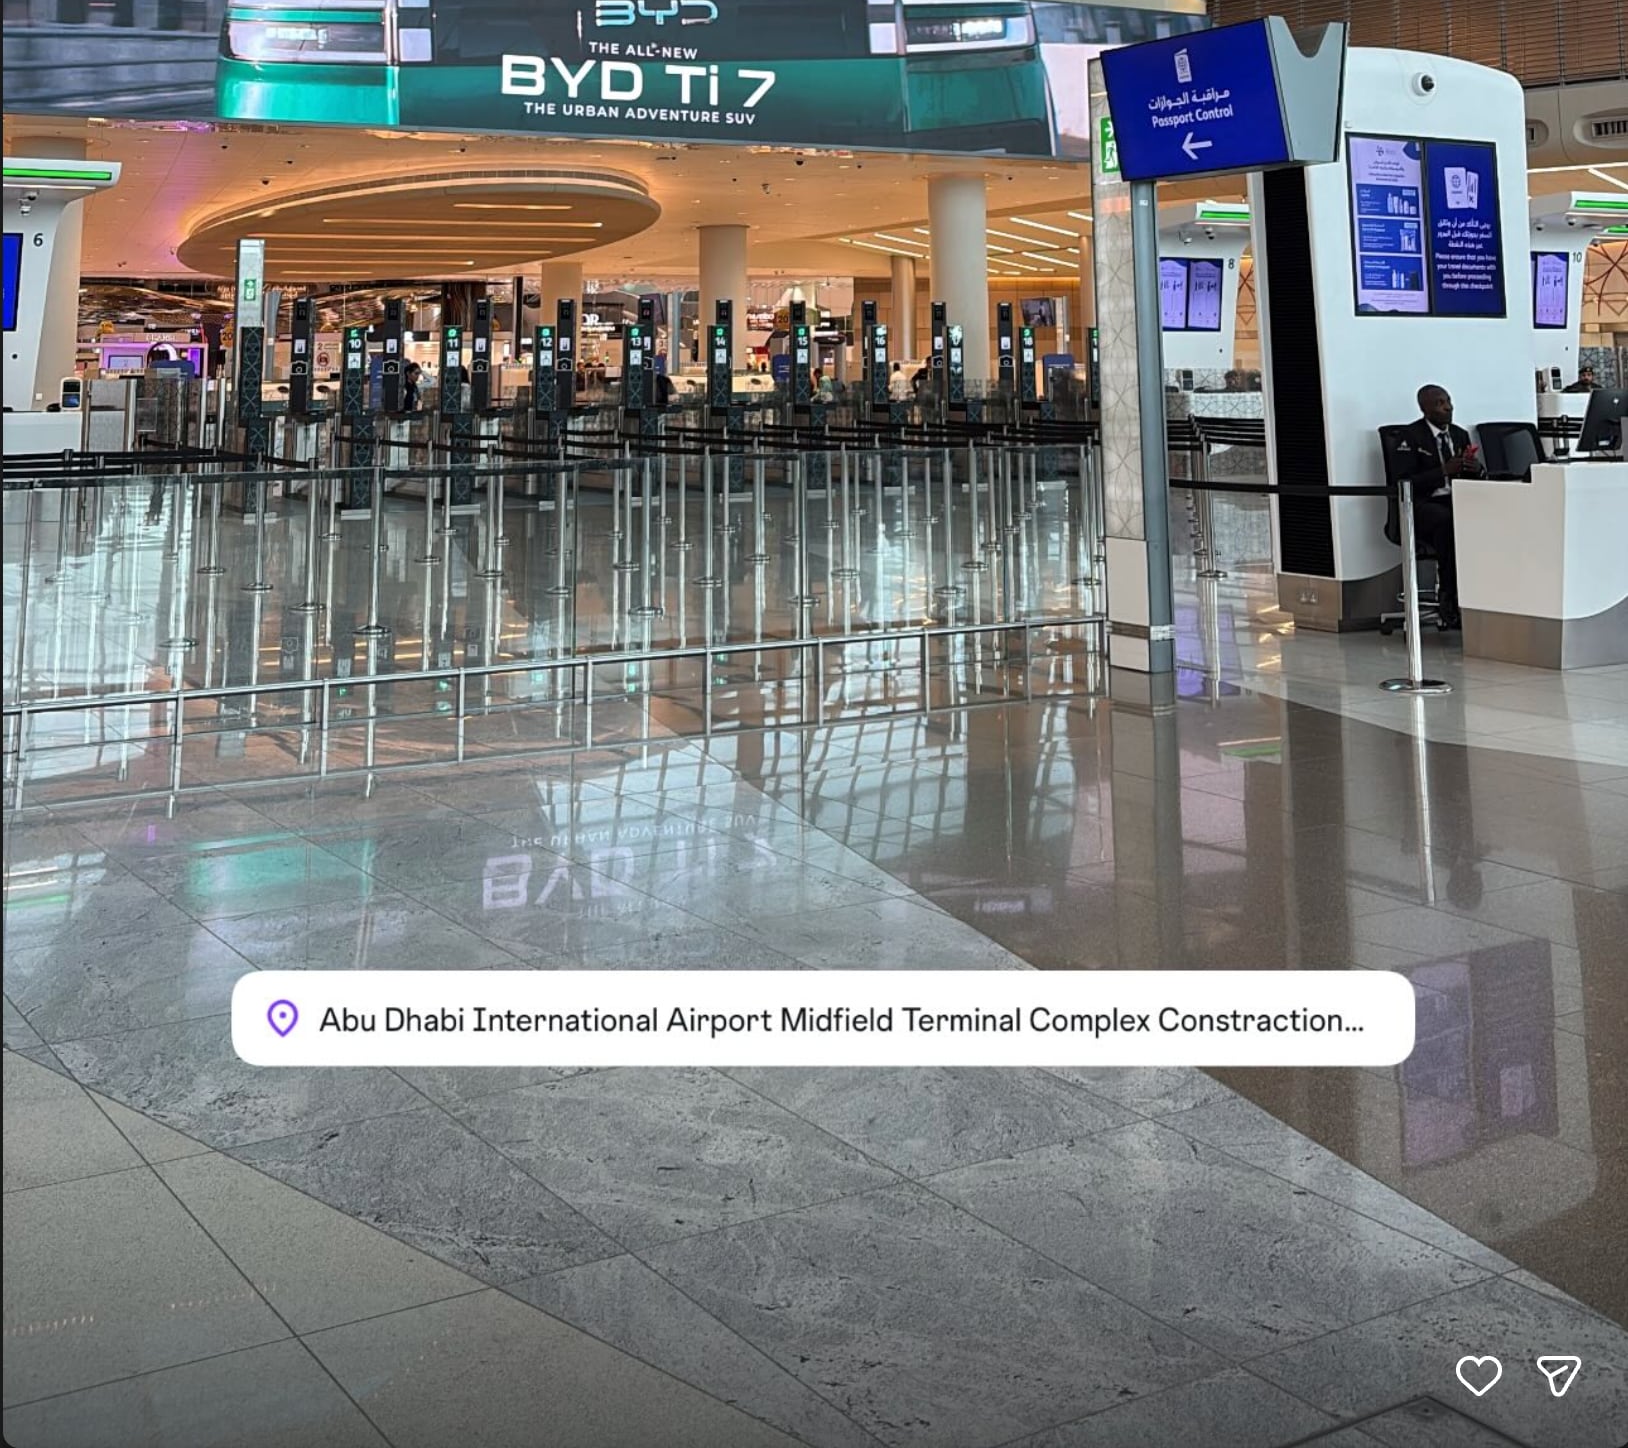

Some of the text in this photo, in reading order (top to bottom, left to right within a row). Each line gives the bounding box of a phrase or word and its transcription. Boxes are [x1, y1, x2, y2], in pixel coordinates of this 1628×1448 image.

[589, 41, 698, 60] THE ALL-NEW
[501, 54, 776, 108] BYD Ti 7
[523, 102, 756, 126] THE URBAN ADVENTURE SUV
[1151, 103, 1234, 129] Passport Control
[33, 232, 44, 247] 6
[1571, 252, 1583, 263] 10
[1227, 258, 1235, 270] 8
[348, 338, 361, 349] 10
[448, 338, 459, 348] 11
[541, 337, 553, 347] 12
[630, 337, 642, 347] 13
[715, 336, 726, 346] 14
[797, 336, 809, 346] 15
[875, 336, 886, 345] 16
